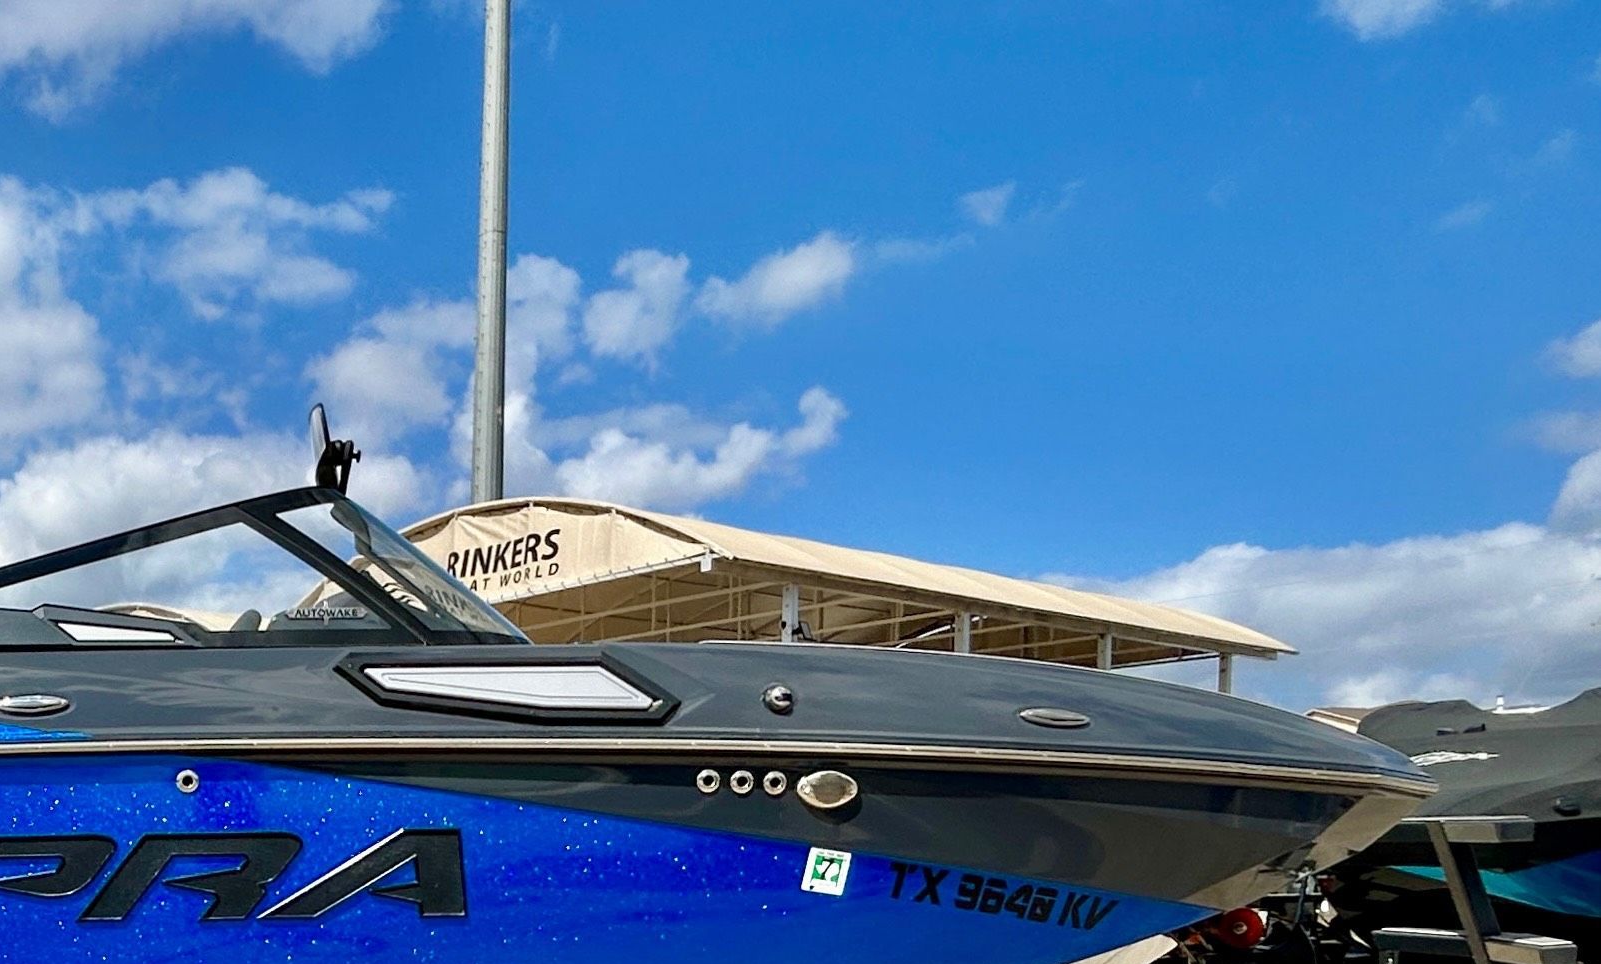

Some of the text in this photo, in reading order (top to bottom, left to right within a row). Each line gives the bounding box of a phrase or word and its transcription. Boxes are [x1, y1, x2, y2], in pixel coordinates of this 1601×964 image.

[447, 529, 561, 578] RINKERS
[469, 563, 560, 591] AT WORLD
[295, 608, 358, 618] AUTOWAKE
[890, 861, 950, 906] TX
[1057, 891, 1121, 930] KV
